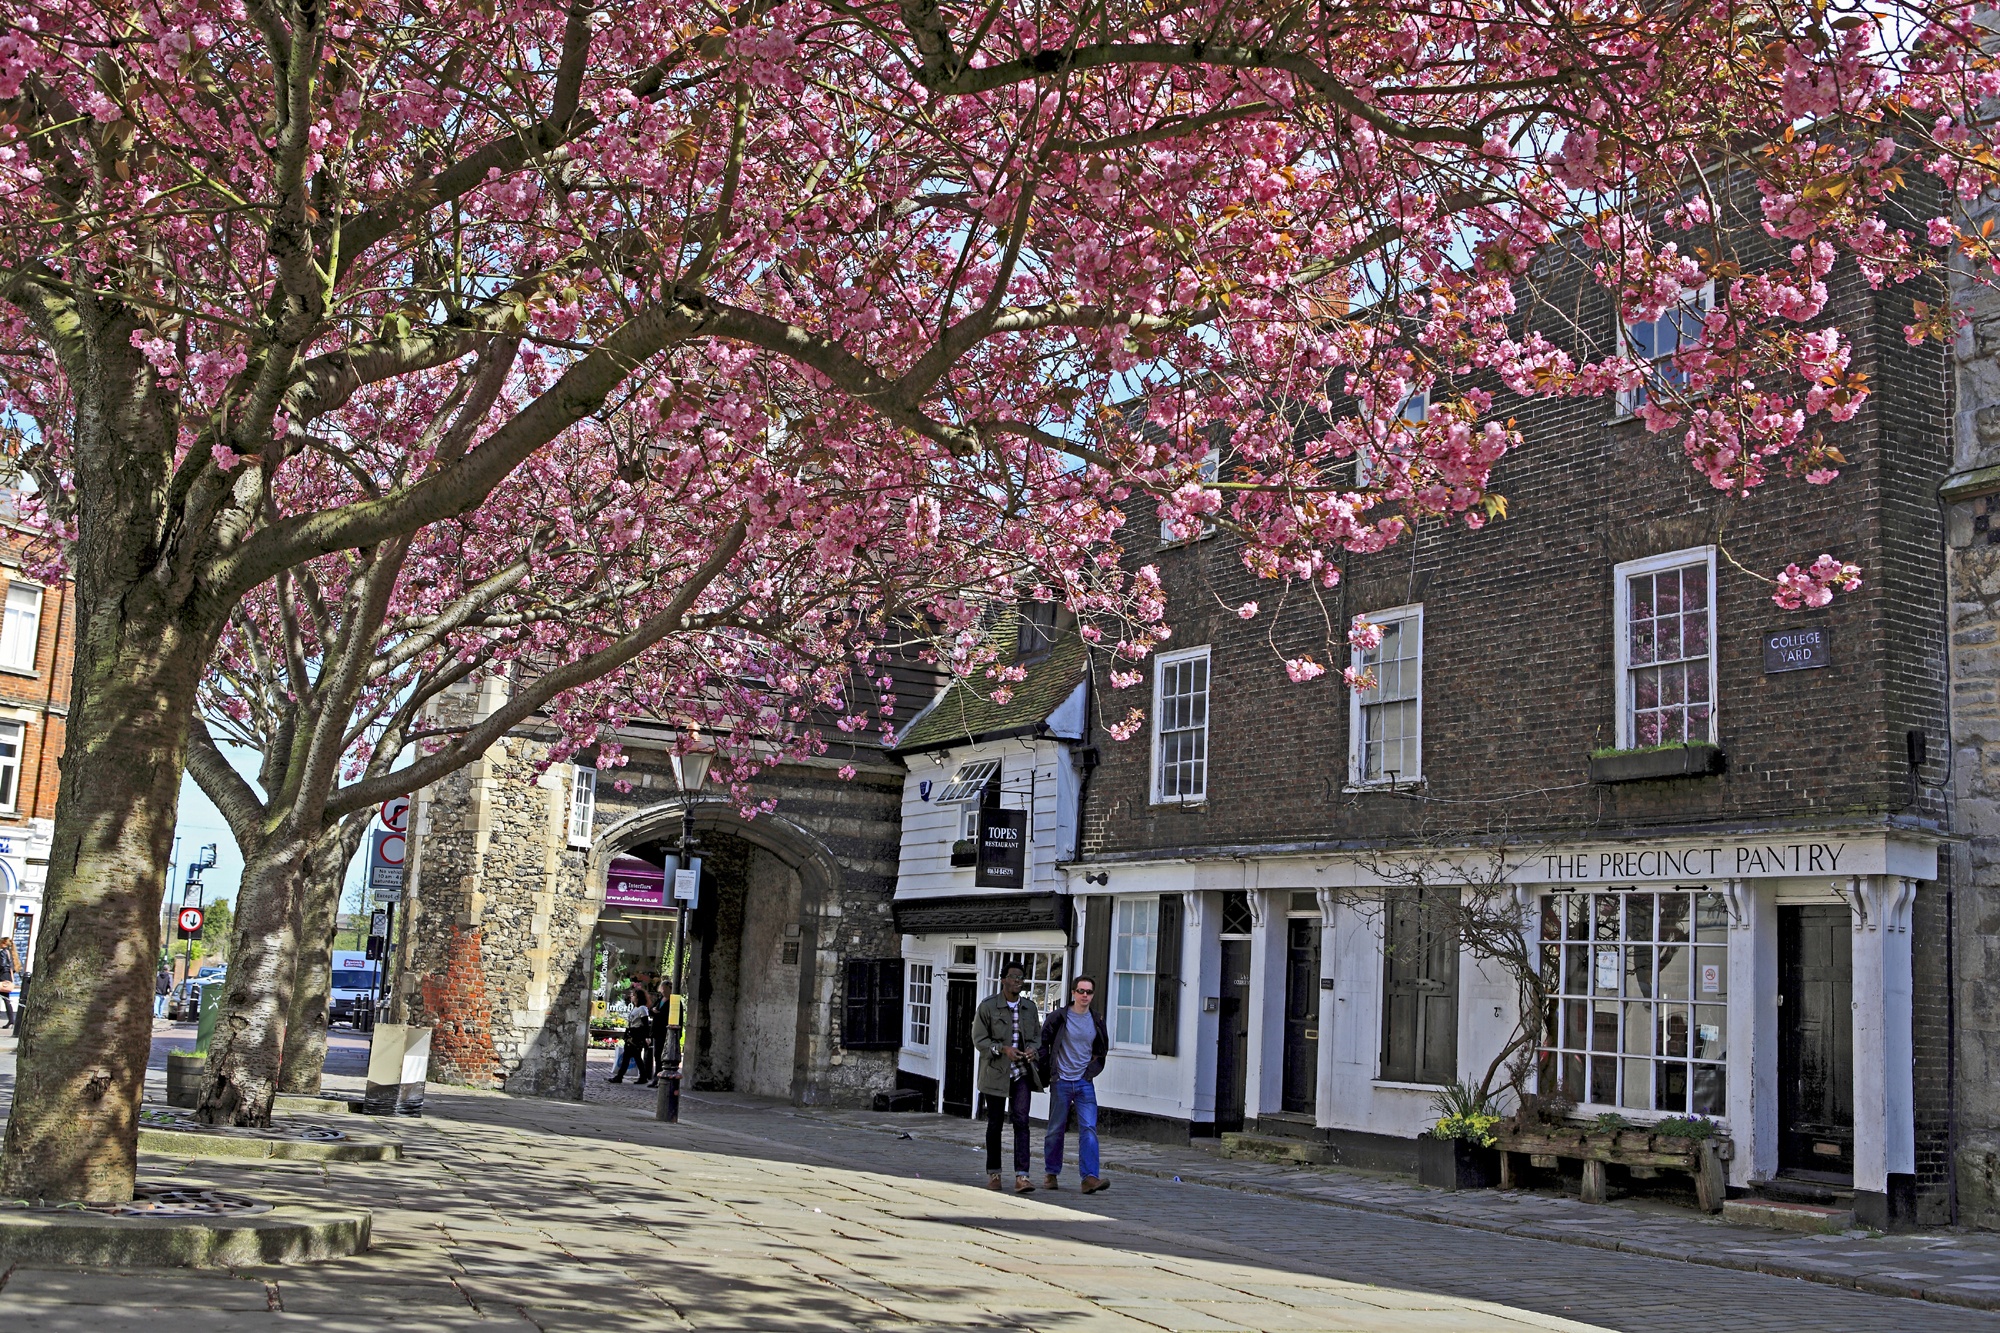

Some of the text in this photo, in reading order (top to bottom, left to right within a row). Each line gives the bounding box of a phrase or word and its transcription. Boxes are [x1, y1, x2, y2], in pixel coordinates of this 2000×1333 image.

[1771, 632, 1820, 649] COLLEGE
[1780, 648, 1812, 662] YARD
[988, 827, 1018, 840] TOPES
[1542, 843, 1845, 878] THE PRECINCT PANTRY
[606, 895, 659, 903] www.slinders.co.uk
